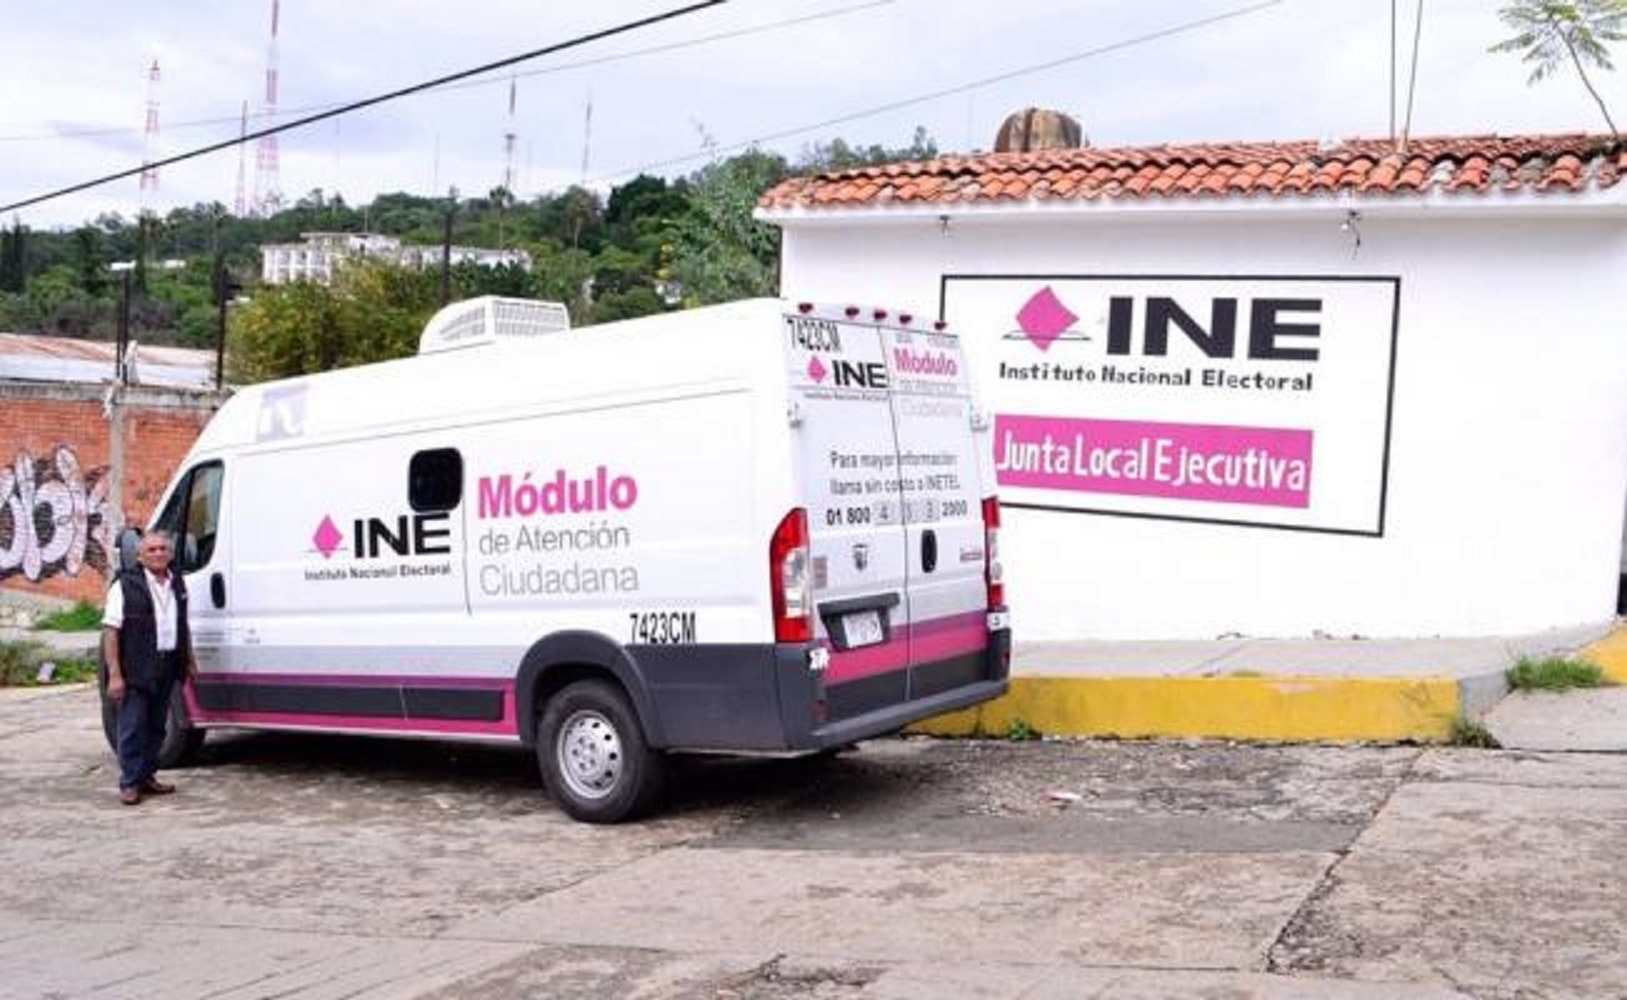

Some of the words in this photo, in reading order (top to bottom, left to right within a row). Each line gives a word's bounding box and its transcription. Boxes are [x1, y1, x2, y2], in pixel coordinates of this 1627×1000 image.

[1107, 296, 1322, 361] INE
[832, 359, 888, 389] INE
[1000, 362, 1096, 382] Instituto
[1101, 366, 1191, 387] Nacional
[1202, 369, 1313, 392] Electoral
[830, 451, 858, 470] Para
[997, 430, 1069, 472] Junta
[1074, 434, 1147, 481] Local
[1154, 439, 1307, 491] Ejecutiva
[478, 465, 639, 520] Módulo
[830, 478, 863, 495] llama
[866, 475, 883, 493] sin
[827, 508, 842, 526] 01
[847, 506, 870, 525] 800
[354, 512, 451, 559] INE
[479, 528, 510, 555] de
[516, 519, 630, 552] Atención
[304, 569, 347, 581] Instituto
[350, 565, 398, 579] Nacional
[400, 561, 451, 577] Electoral
[479, 561, 640, 597] Ciudadana
[629, 611, 697, 644] 7423CM
